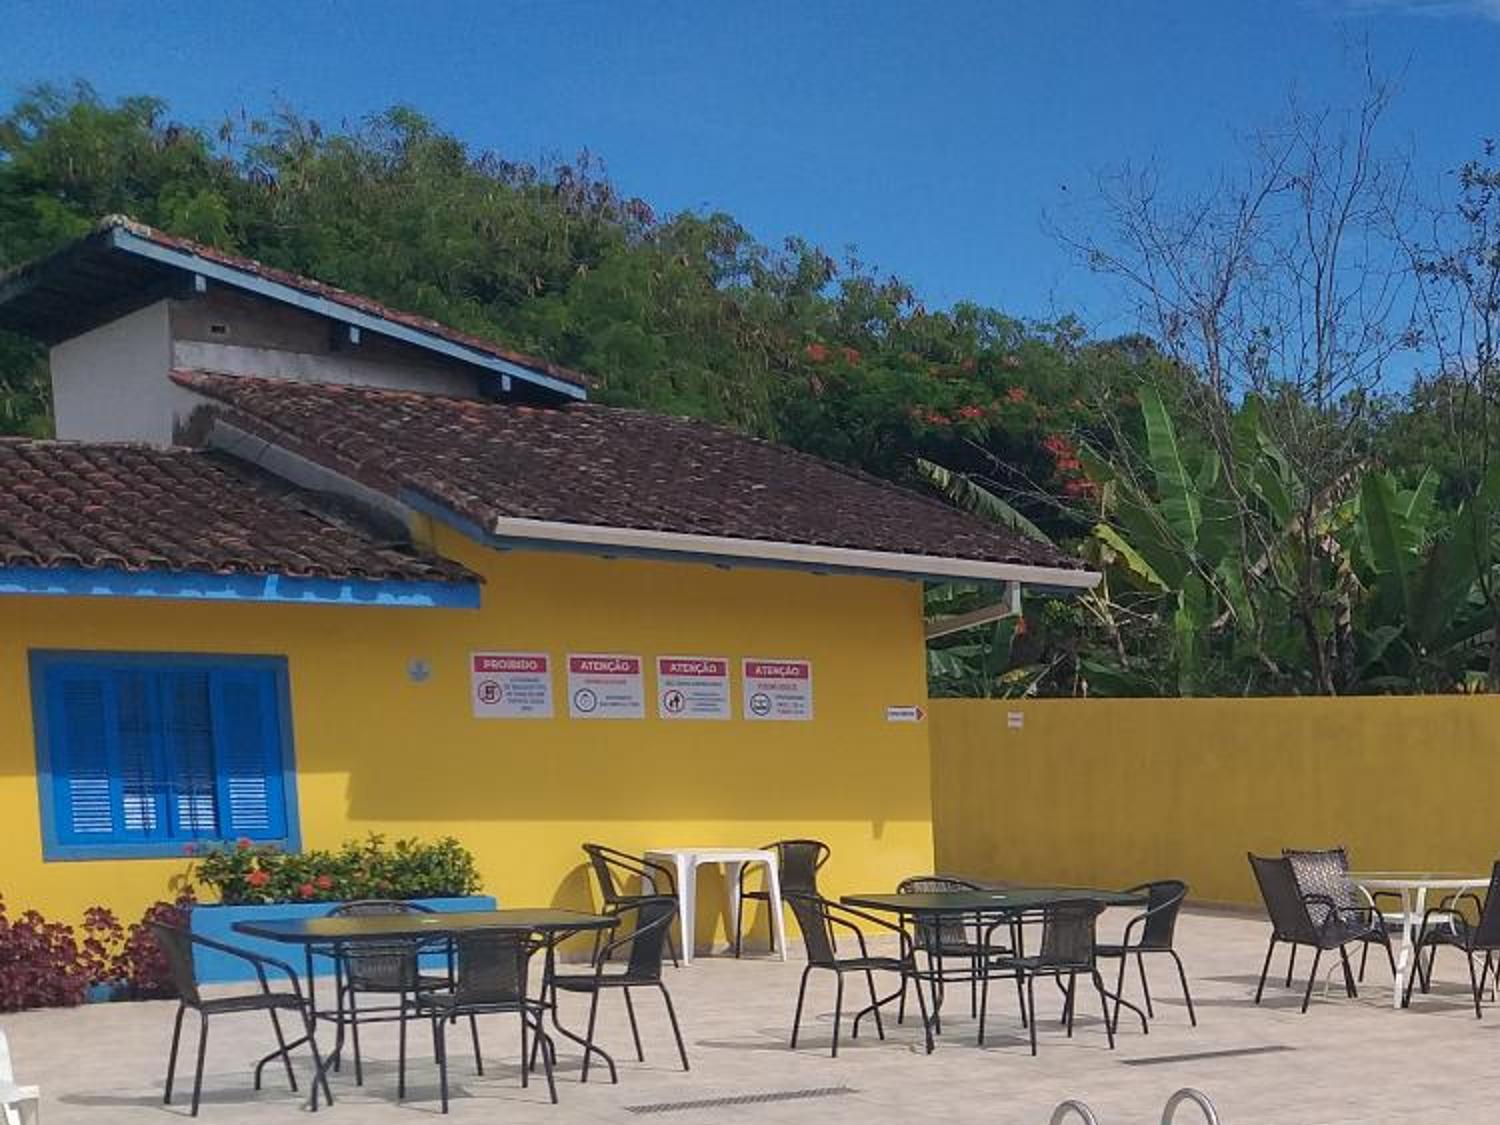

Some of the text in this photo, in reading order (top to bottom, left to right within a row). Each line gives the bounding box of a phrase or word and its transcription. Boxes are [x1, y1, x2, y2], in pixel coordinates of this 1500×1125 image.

[483, 658, 537, 670] PROIBIDO
[581, 659, 630, 673] ATENÇÃO
[670, 661, 717, 675] ATENÇÃO
[755, 664, 800, 677] ATENÇÃO
